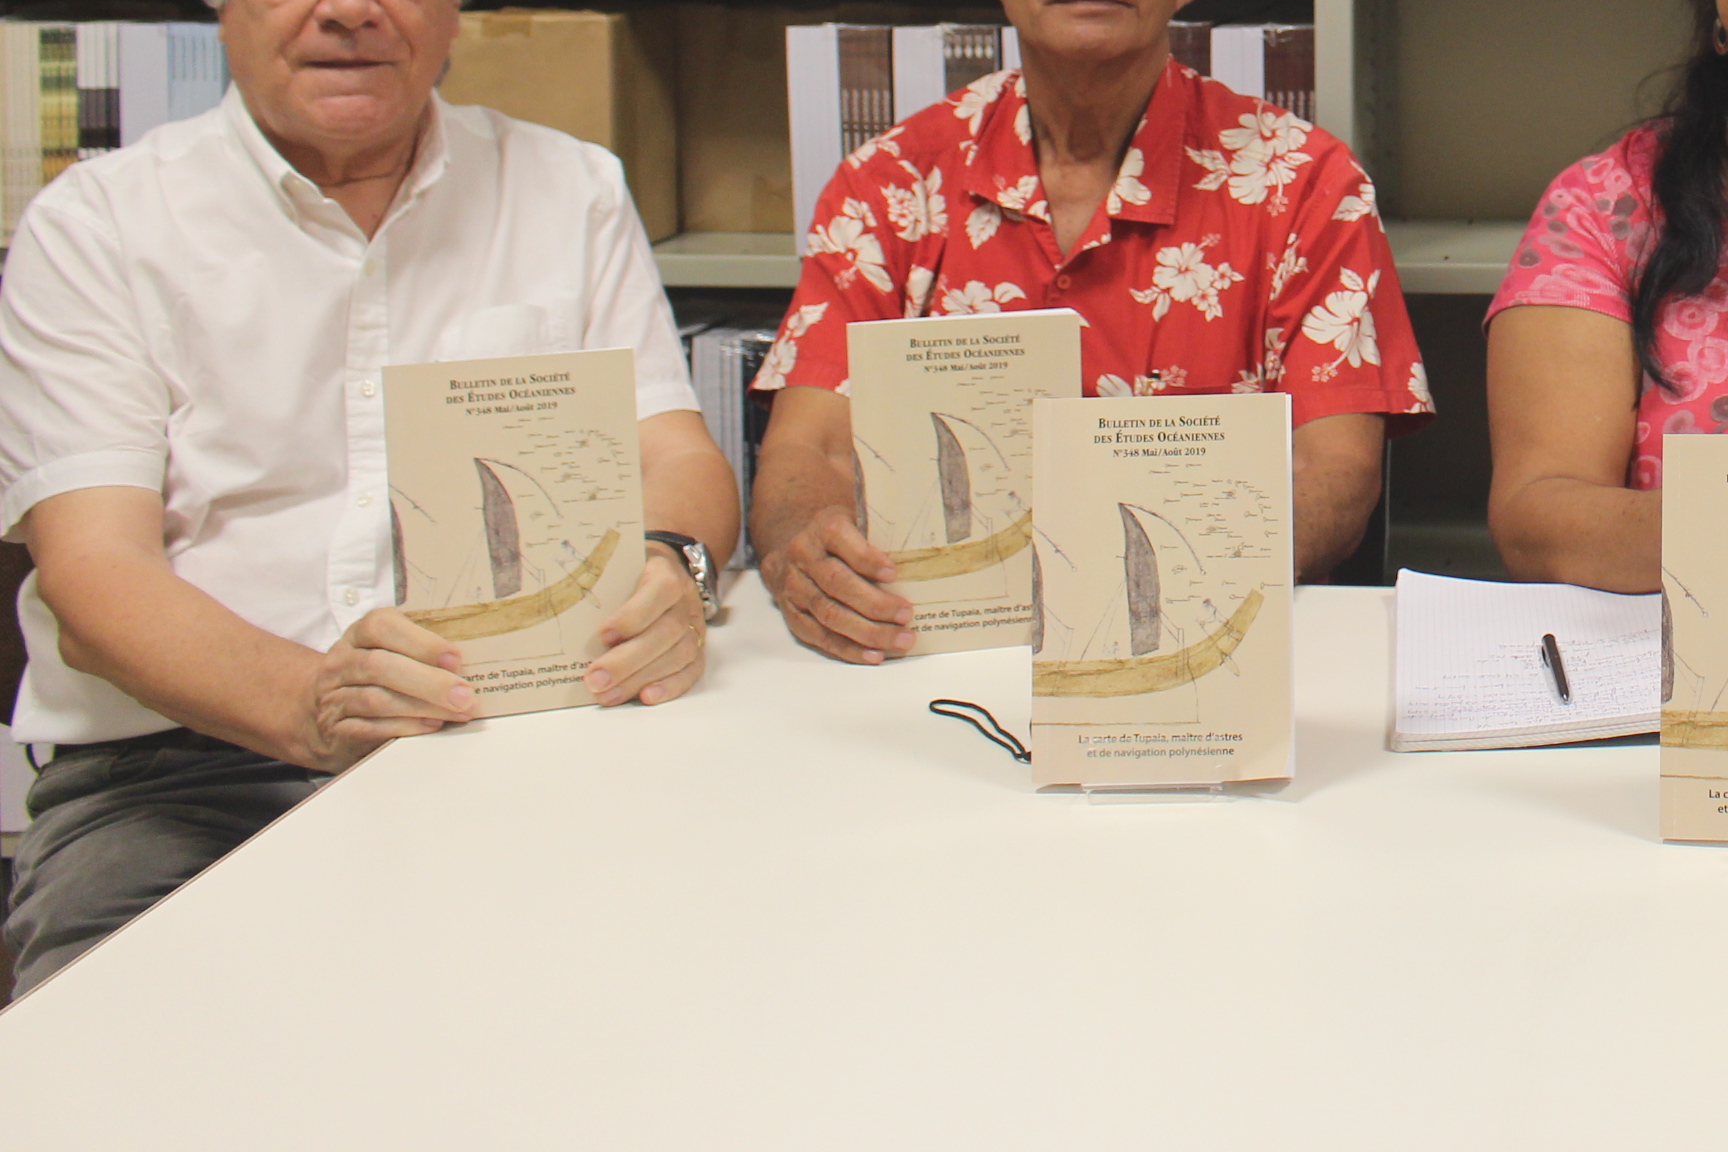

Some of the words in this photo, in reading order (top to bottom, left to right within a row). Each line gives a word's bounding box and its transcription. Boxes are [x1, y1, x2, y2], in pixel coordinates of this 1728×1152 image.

[910, 338, 953, 348] BULLETIN
[956, 338, 967, 346] DE
[982, 334, 1020, 344] SOCIÉTÉ
[906, 354, 923, 362] DES
[926, 349, 961, 361] ÉTUDES
[963, 348, 1025, 358] OCÉANIENNES
[449, 379, 497, 390] BULLETIN
[500, 378, 512, 386] DE
[515, 377, 526, 385] LA
[529, 372, 570, 384] SOCIÉTÉ
[446, 396, 464, 404] DES
[467, 390, 506, 403] ÉTUDES
[508, 387, 576, 399] OCÉANIENNES
[1098, 418, 1146, 429] BULLETIN
[1149, 419, 1162, 428] DE
[1165, 419, 1176, 427] LA
[1179, 416, 1220, 426] SOCIÉTÉ
[1094, 435, 1112, 444] DES
[1116, 429, 1154, 443] ÉTUDES
[1157, 432, 1225, 442] OCÉANIENNES
[1113, 449, 1140, 458] N°348
[1142, 447, 1182, 456] Mai/Août
[1184, 447, 1206, 456] 2019
[914, 612, 937, 621] carte
[951, 609, 982, 618] Tupaia,
[984, 606, 1012, 614] maître
[921, 624, 932, 632] de
[934, 621, 980, 631] navigation
[487, 672, 500, 680] de
[500, 668, 536, 679] Tupaia,
[537, 664, 568, 673] maître
[482, 681, 534, 694] navigation
[1079, 735, 1089, 744] La
[1092, 735, 1117, 744] carte
[1119, 734, 1131, 743] de
[1133, 733, 1168, 745] Tupaia,
[1171, 732, 1202, 741] maître
[1205, 730, 1242, 740] d'astres
[1099, 749, 1111, 758] de
[1114, 747, 1166, 760] navigation
[1169, 745, 1234, 758] polynésienne
[1709, 790, 1720, 798] La
